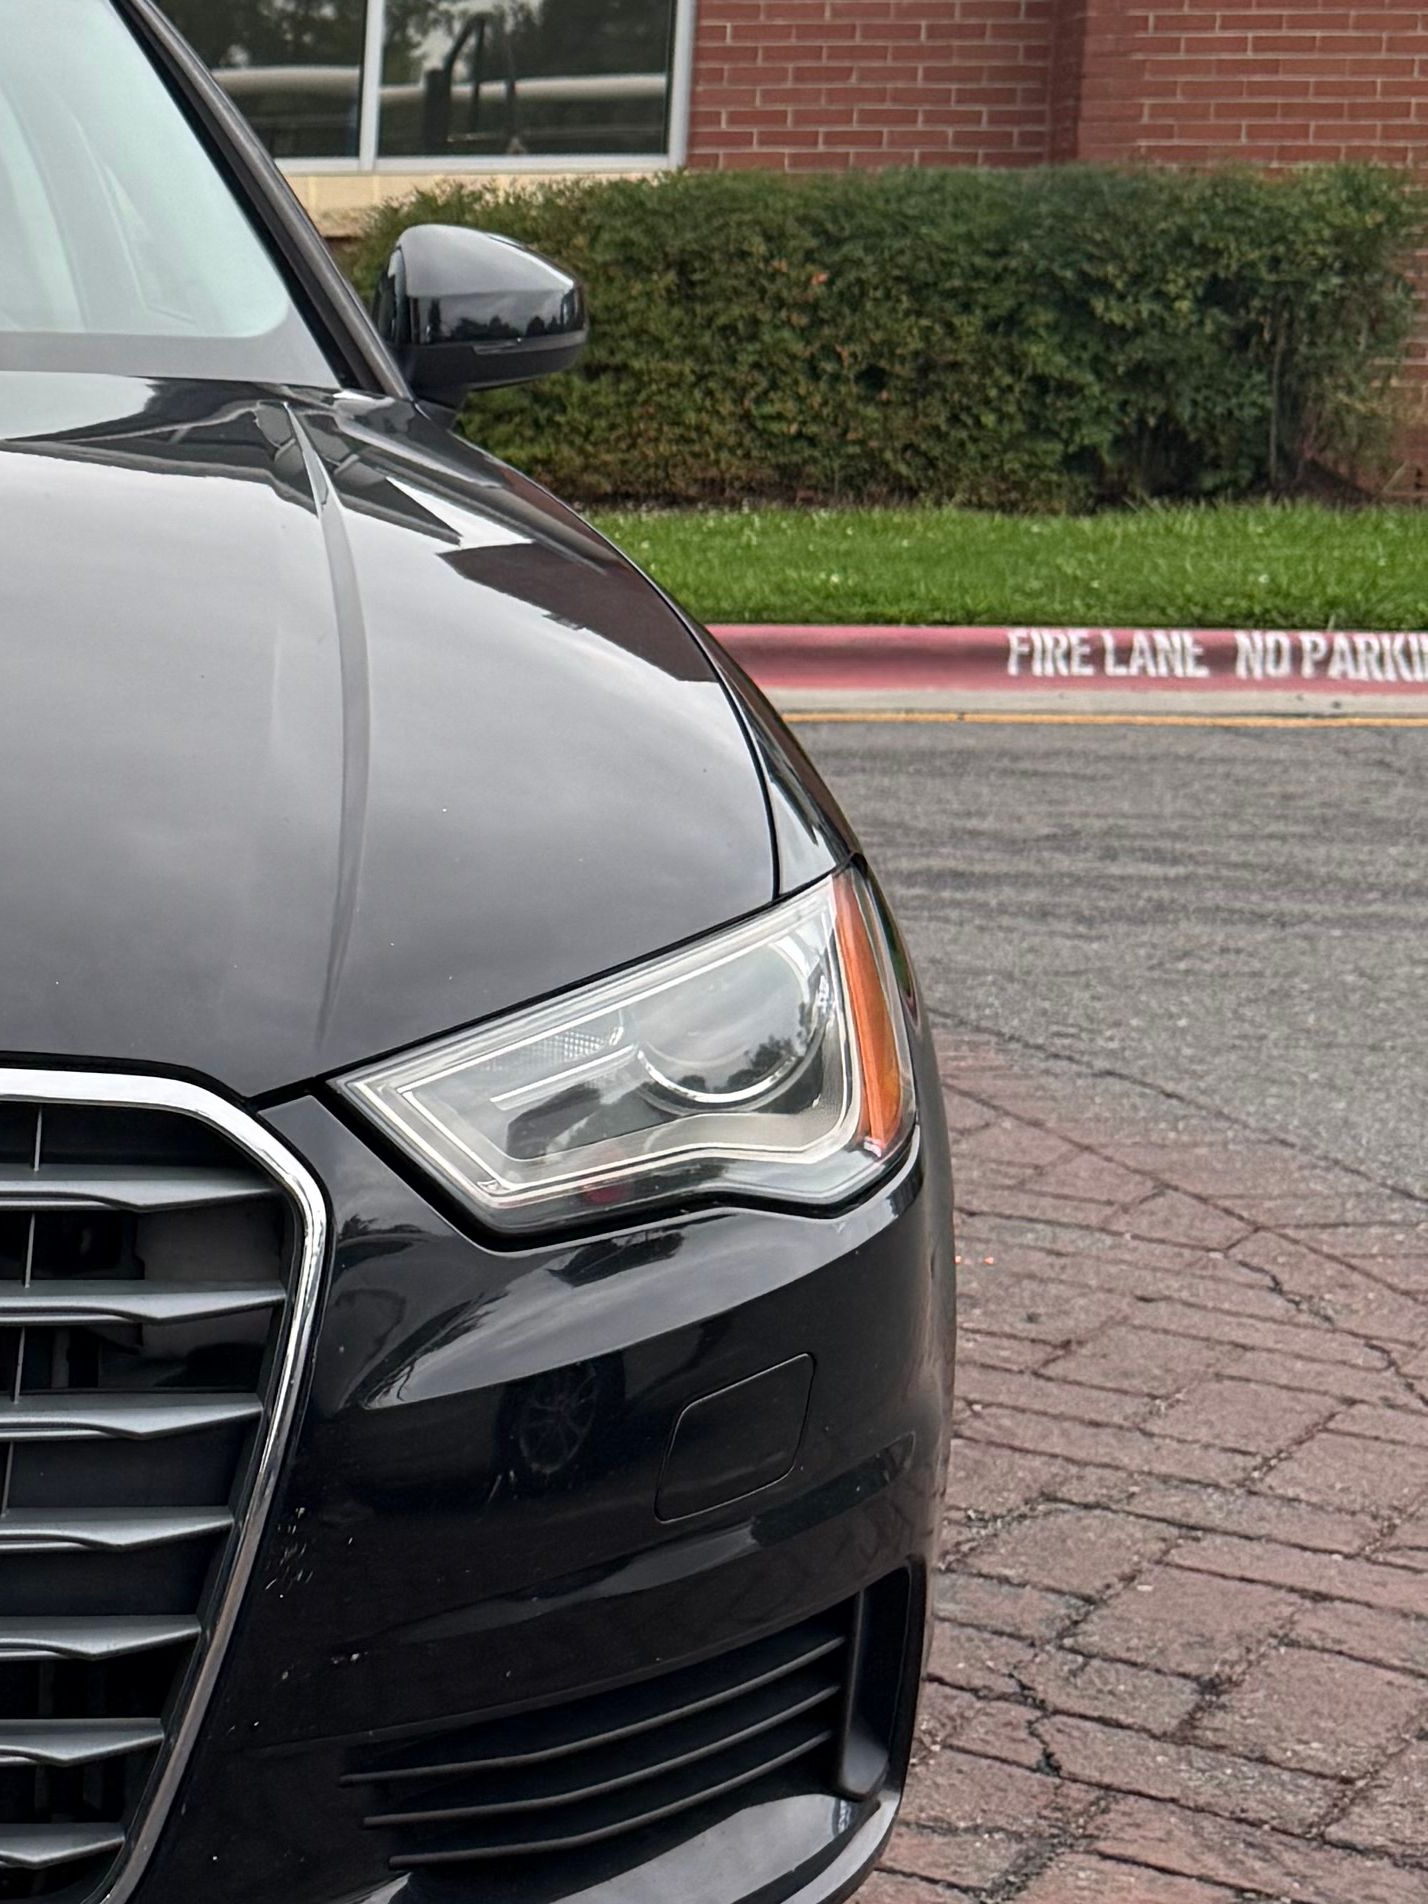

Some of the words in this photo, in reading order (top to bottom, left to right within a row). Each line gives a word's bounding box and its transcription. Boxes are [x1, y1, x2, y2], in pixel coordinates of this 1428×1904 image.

[1007, 628, 1095, 677] FIRE
[1101, 630, 1210, 679] LANE
[1234, 631, 1293, 680] NO
